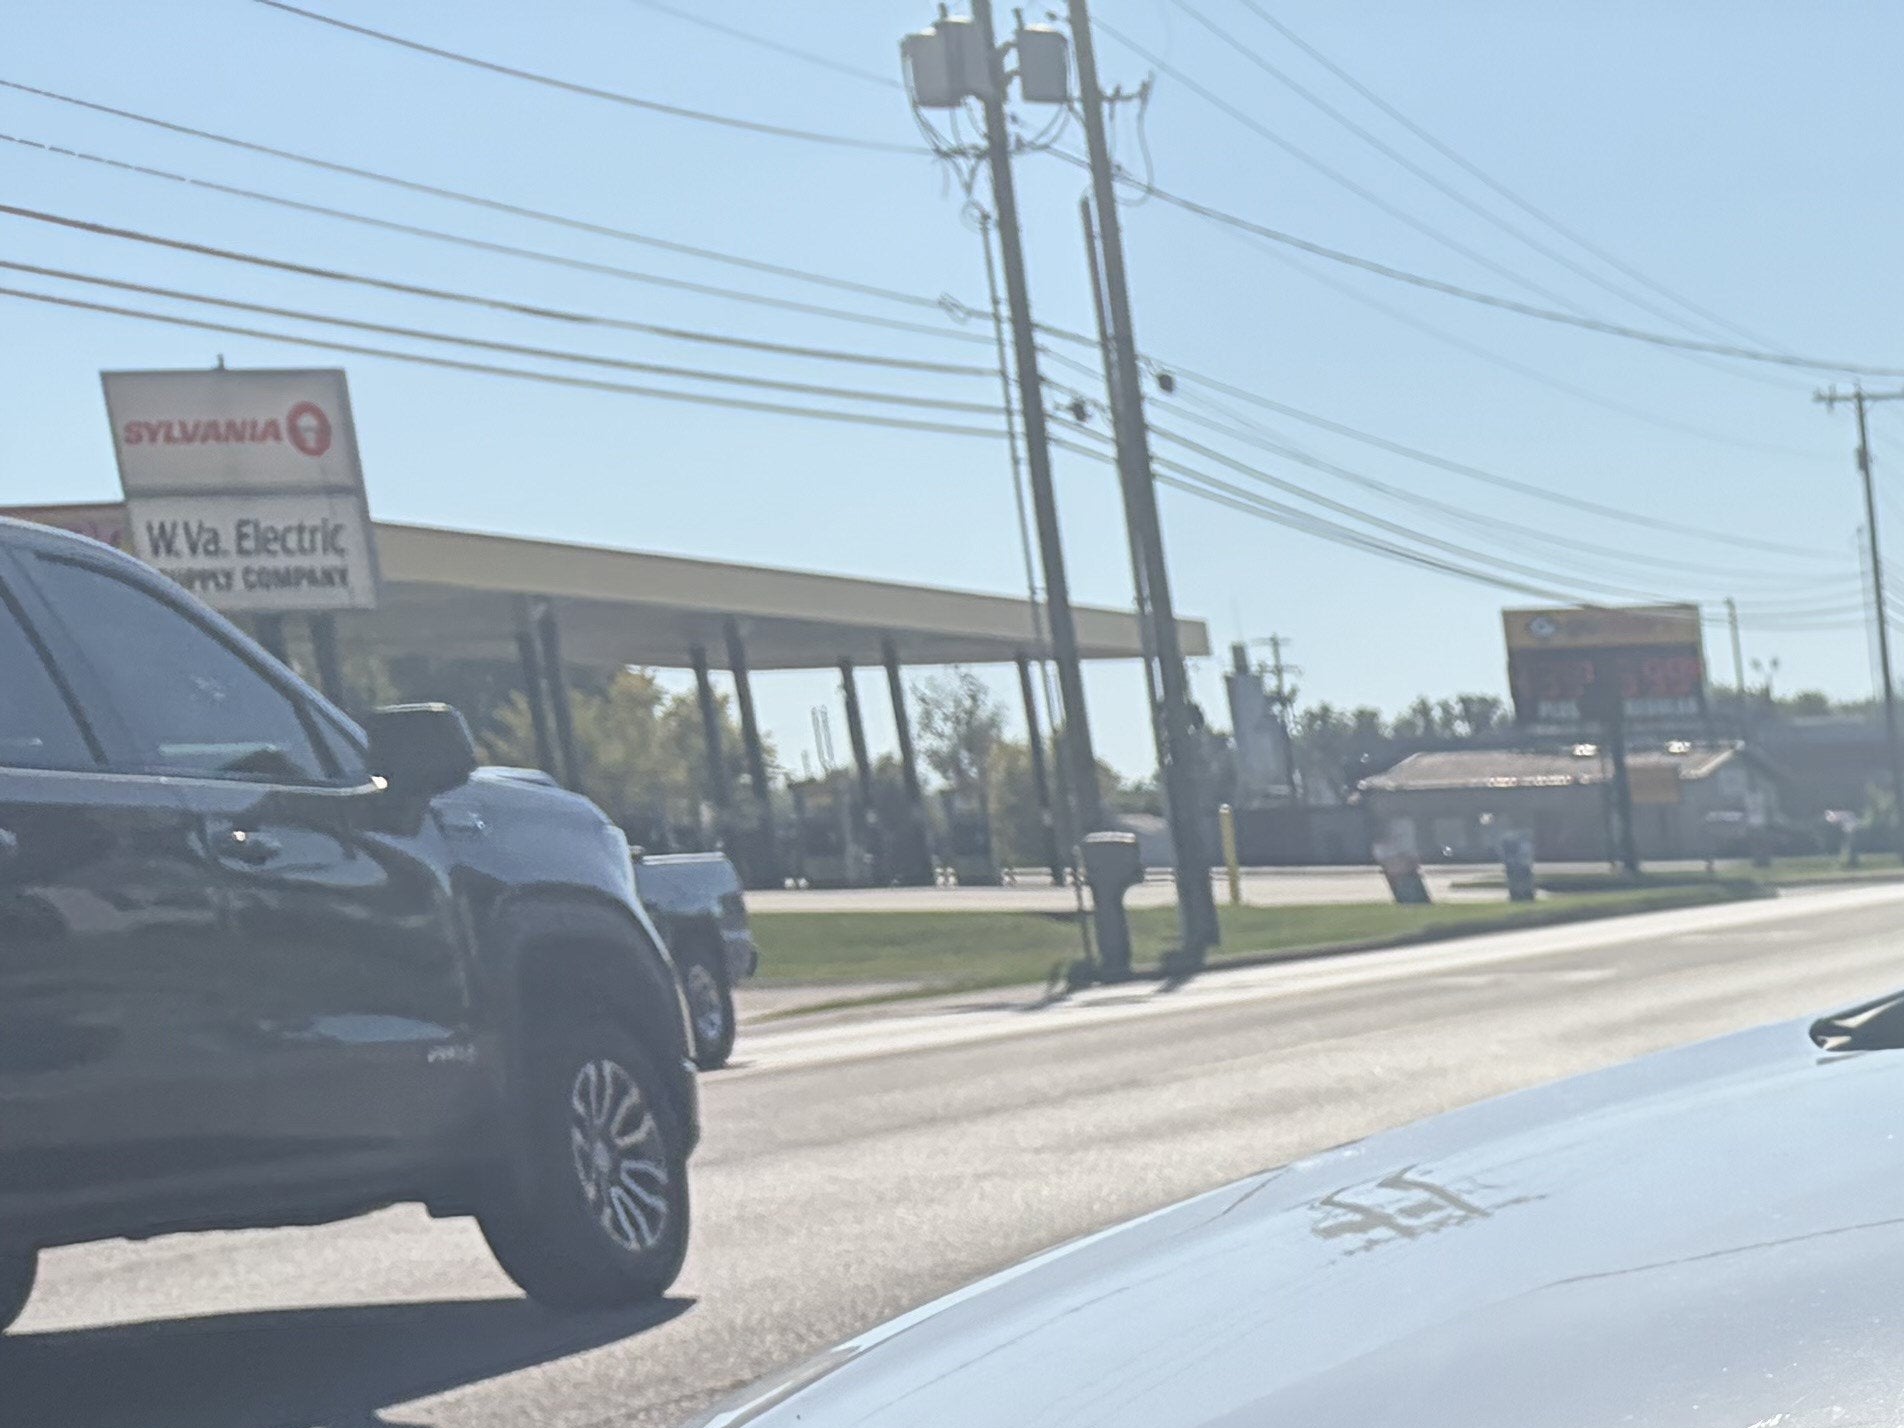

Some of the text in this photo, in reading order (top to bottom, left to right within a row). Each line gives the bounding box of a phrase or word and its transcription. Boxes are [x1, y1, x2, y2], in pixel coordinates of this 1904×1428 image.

[122, 417, 284, 446] SYLVANIA
[234, 515, 347, 557] Electric
[240, 562, 349, 591] COMPANY
